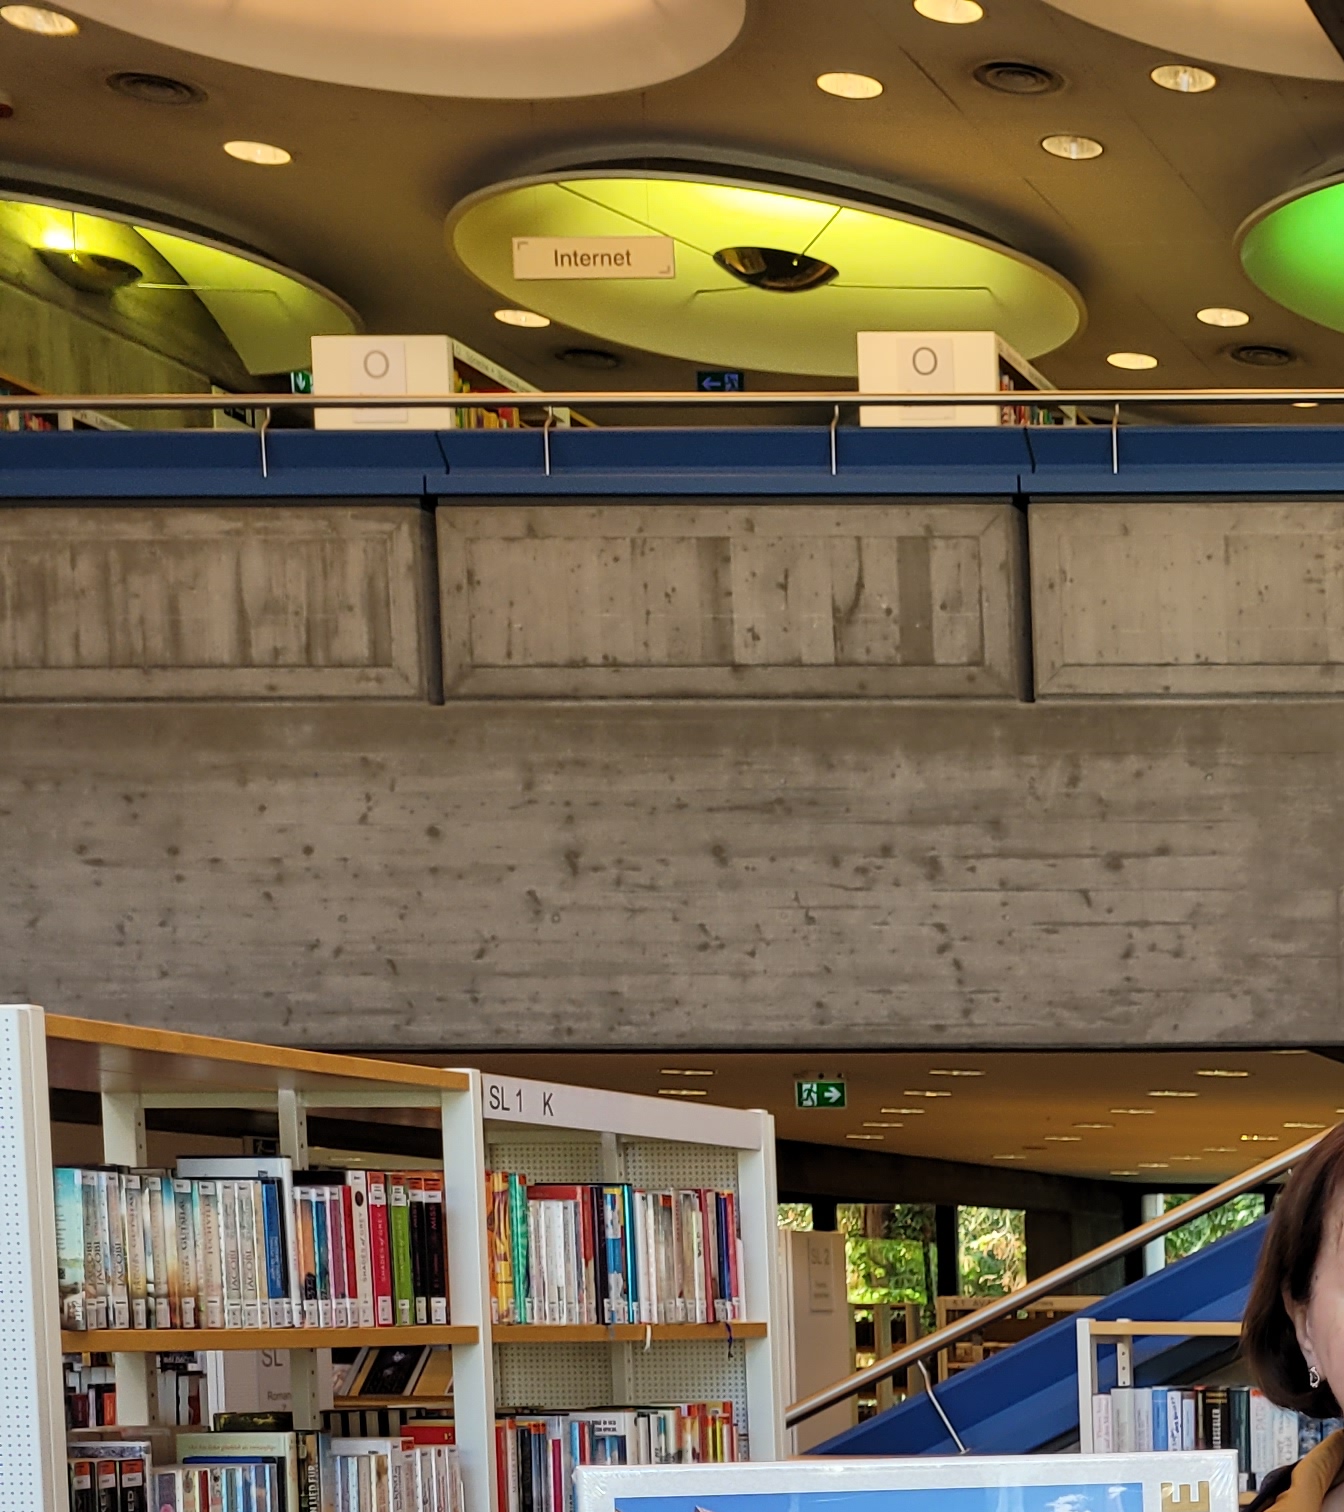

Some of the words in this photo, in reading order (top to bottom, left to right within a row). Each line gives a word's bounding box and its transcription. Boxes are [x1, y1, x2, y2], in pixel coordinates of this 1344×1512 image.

[552, 247, 632, 270] Internet
[363, 349, 390, 380] O
[911, 346, 938, 377] O
[489, 1086, 511, 1111] SL
[516, 1089, 523, 1112] 1
[542, 1092, 554, 1117] K
